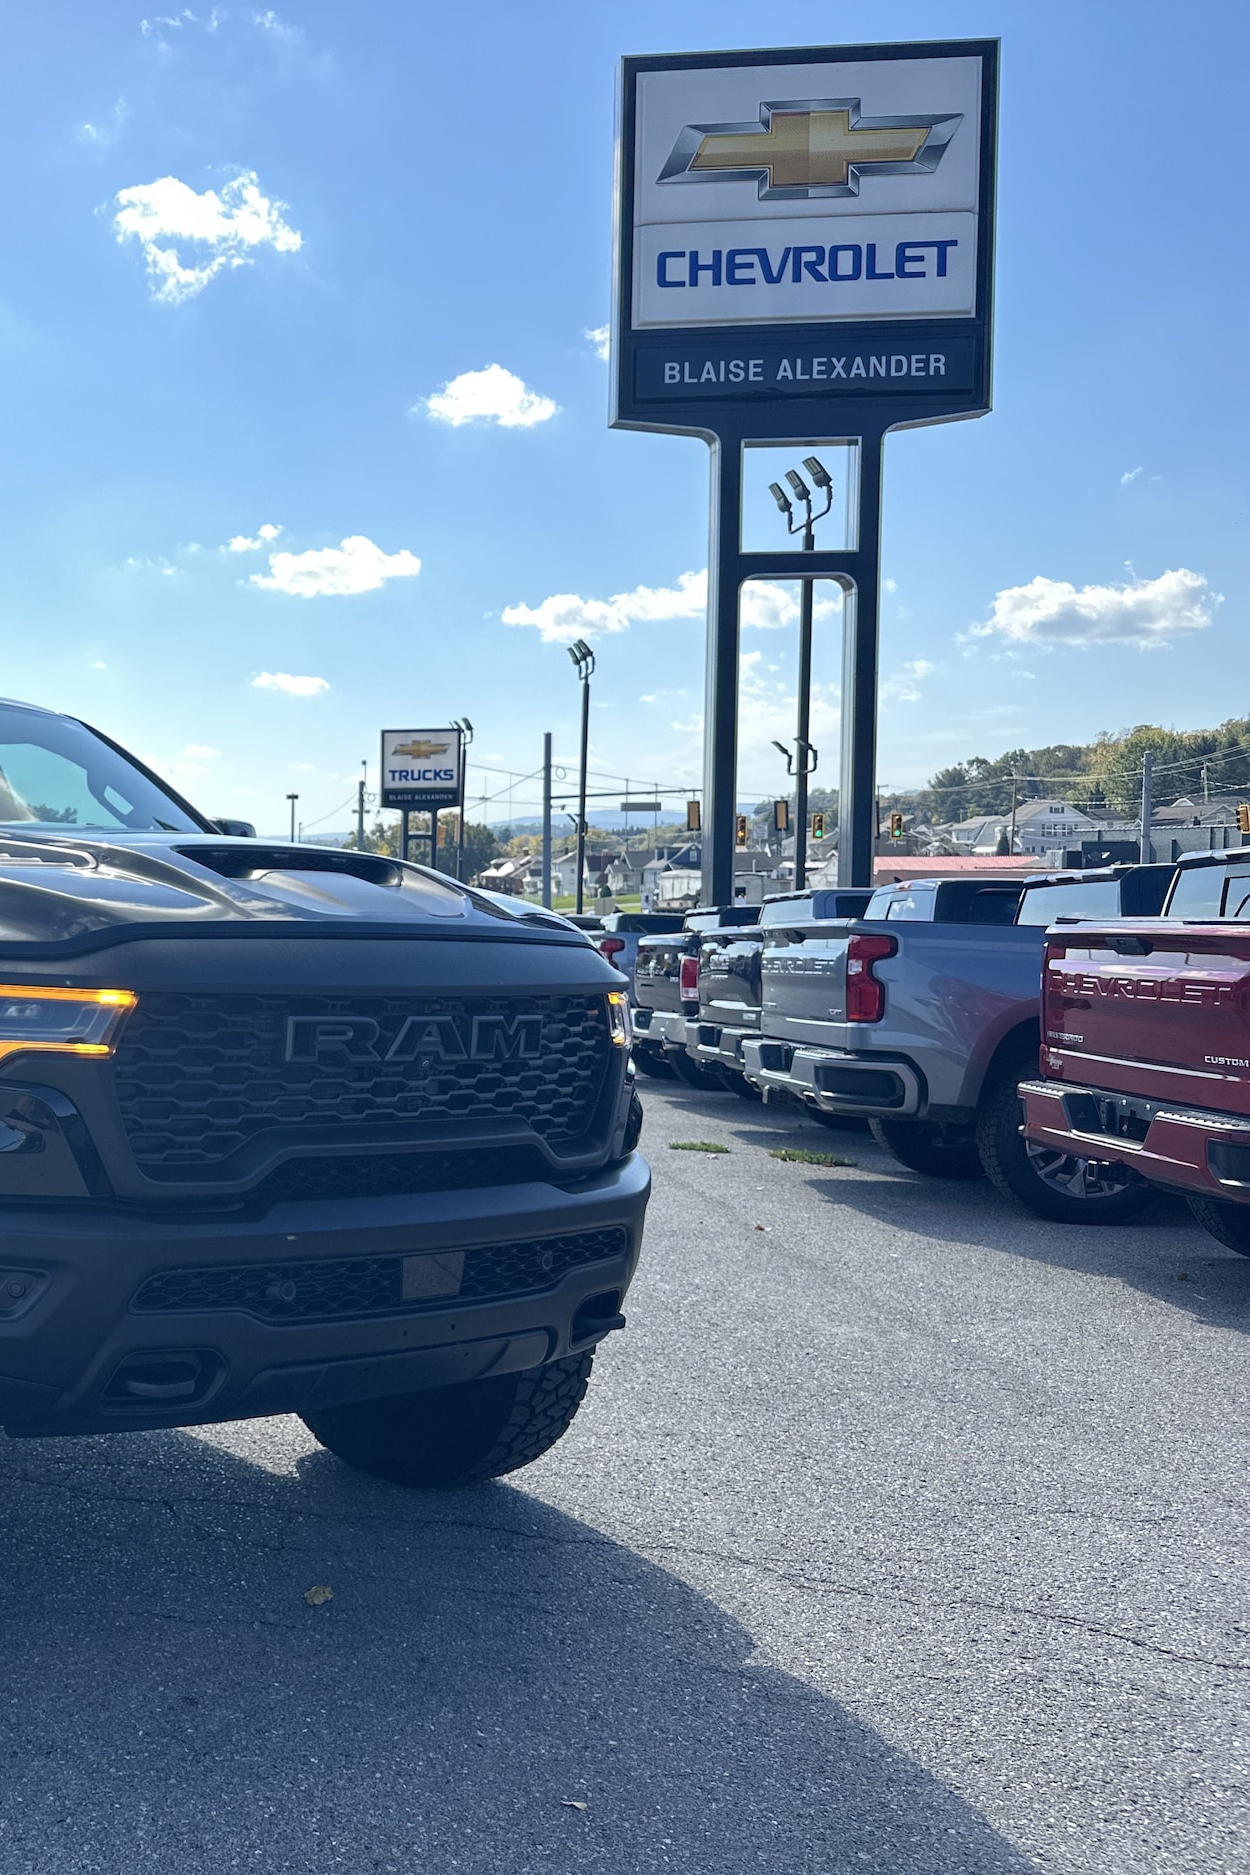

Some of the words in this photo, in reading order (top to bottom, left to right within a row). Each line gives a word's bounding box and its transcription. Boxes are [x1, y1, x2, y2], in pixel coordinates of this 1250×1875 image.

[656, 239, 958, 288] CHEVROLET
[663, 359, 764, 384] BLAISE
[776, 354, 947, 380] ALEXANDER
[388, 769, 454, 781] TRUCKS
[1050, 974, 1231, 1006] CHEVROLET
[284, 1014, 544, 1063] RAM
[1204, 1055, 1250, 1068] CUSTOM
